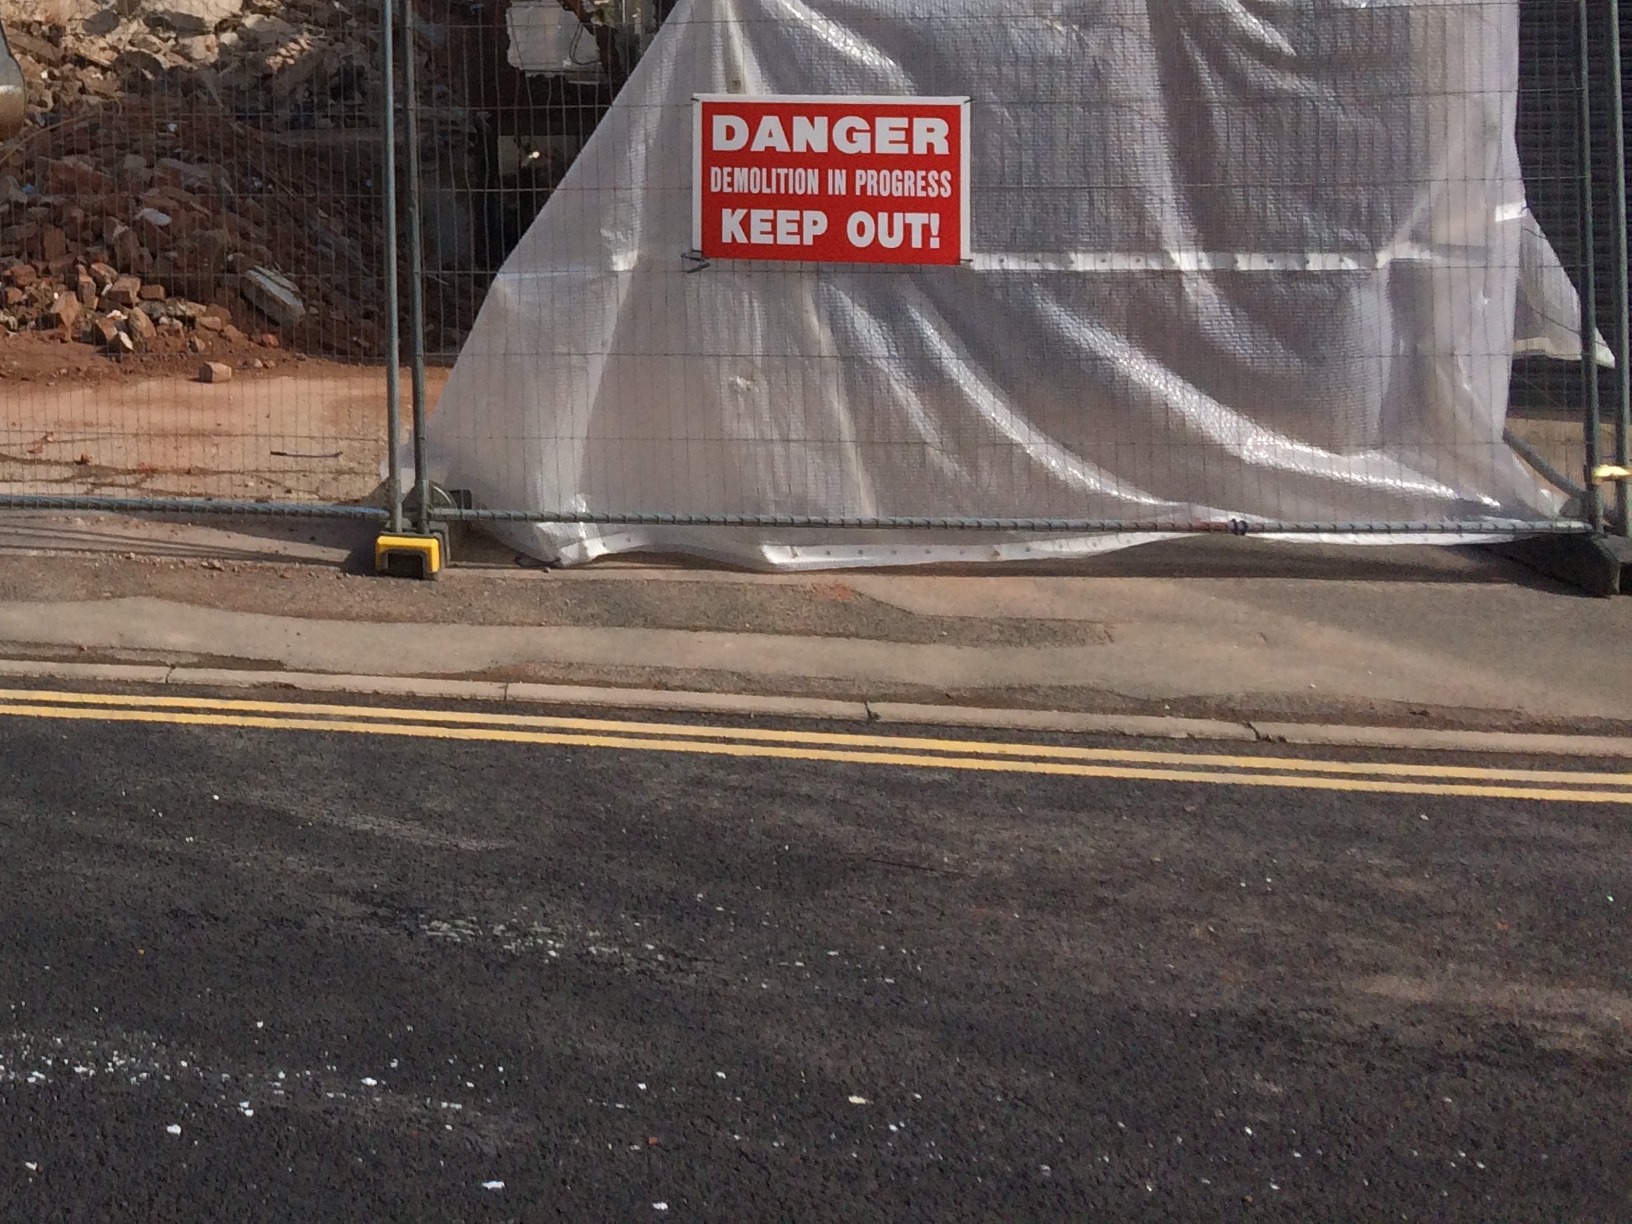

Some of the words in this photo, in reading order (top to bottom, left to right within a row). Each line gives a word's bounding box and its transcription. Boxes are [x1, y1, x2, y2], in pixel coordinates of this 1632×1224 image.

[712, 114, 950, 155] DANGER
[710, 166, 819, 195] DEMOLITION
[827, 168, 847, 196] IN
[855, 169, 952, 198] PROGRESS
[721, 208, 828, 246] KEEP
[846, 210, 941, 249] OUT!
